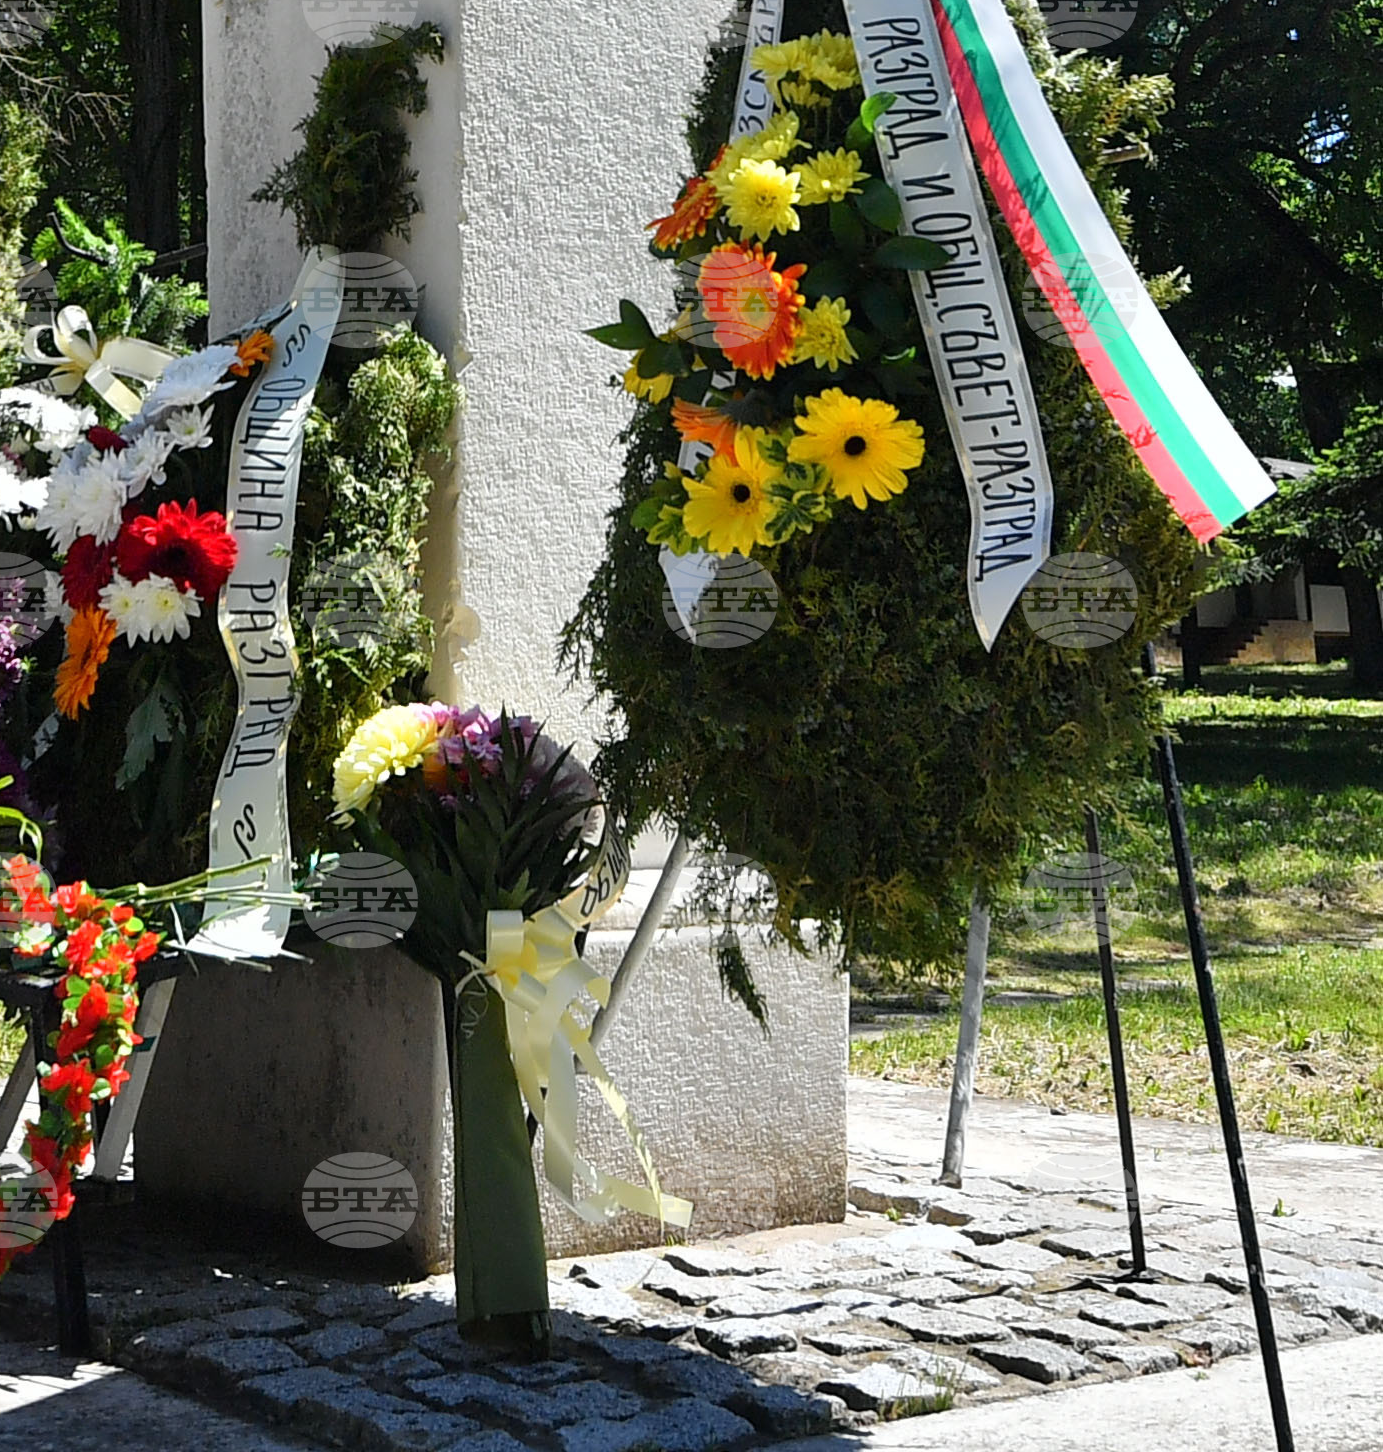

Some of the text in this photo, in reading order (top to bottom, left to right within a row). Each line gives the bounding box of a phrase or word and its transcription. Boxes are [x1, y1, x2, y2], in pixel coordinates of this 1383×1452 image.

[862, 16, 949, 161] РАЗГРАД
[901, 172, 956, 203] И
[234, 377, 307, 532] ОБЩИНА
[224, 578, 295, 779] РАЗГРАД
